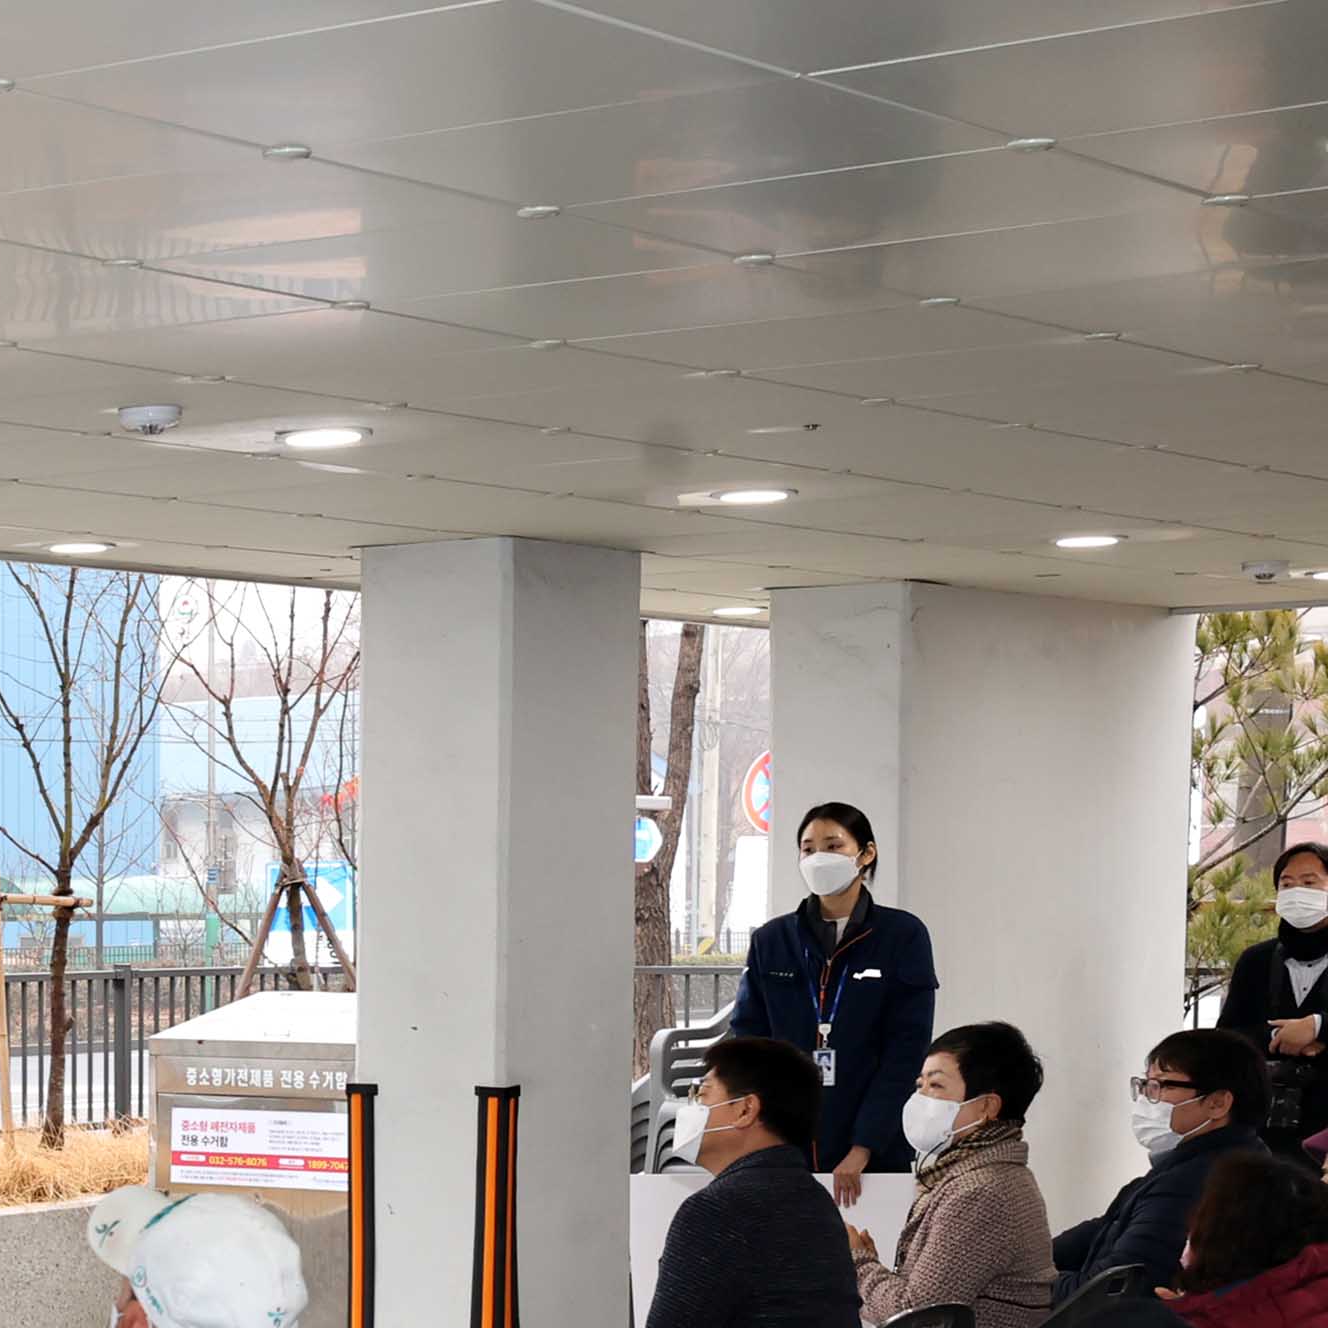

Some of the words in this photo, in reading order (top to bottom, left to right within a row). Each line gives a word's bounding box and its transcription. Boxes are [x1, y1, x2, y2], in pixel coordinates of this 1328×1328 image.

[186, 1067, 273, 1087] 중소형가전제품
[280, 1070, 305, 1089] 전용
[309, 1070, 348, 1090] 수거함
